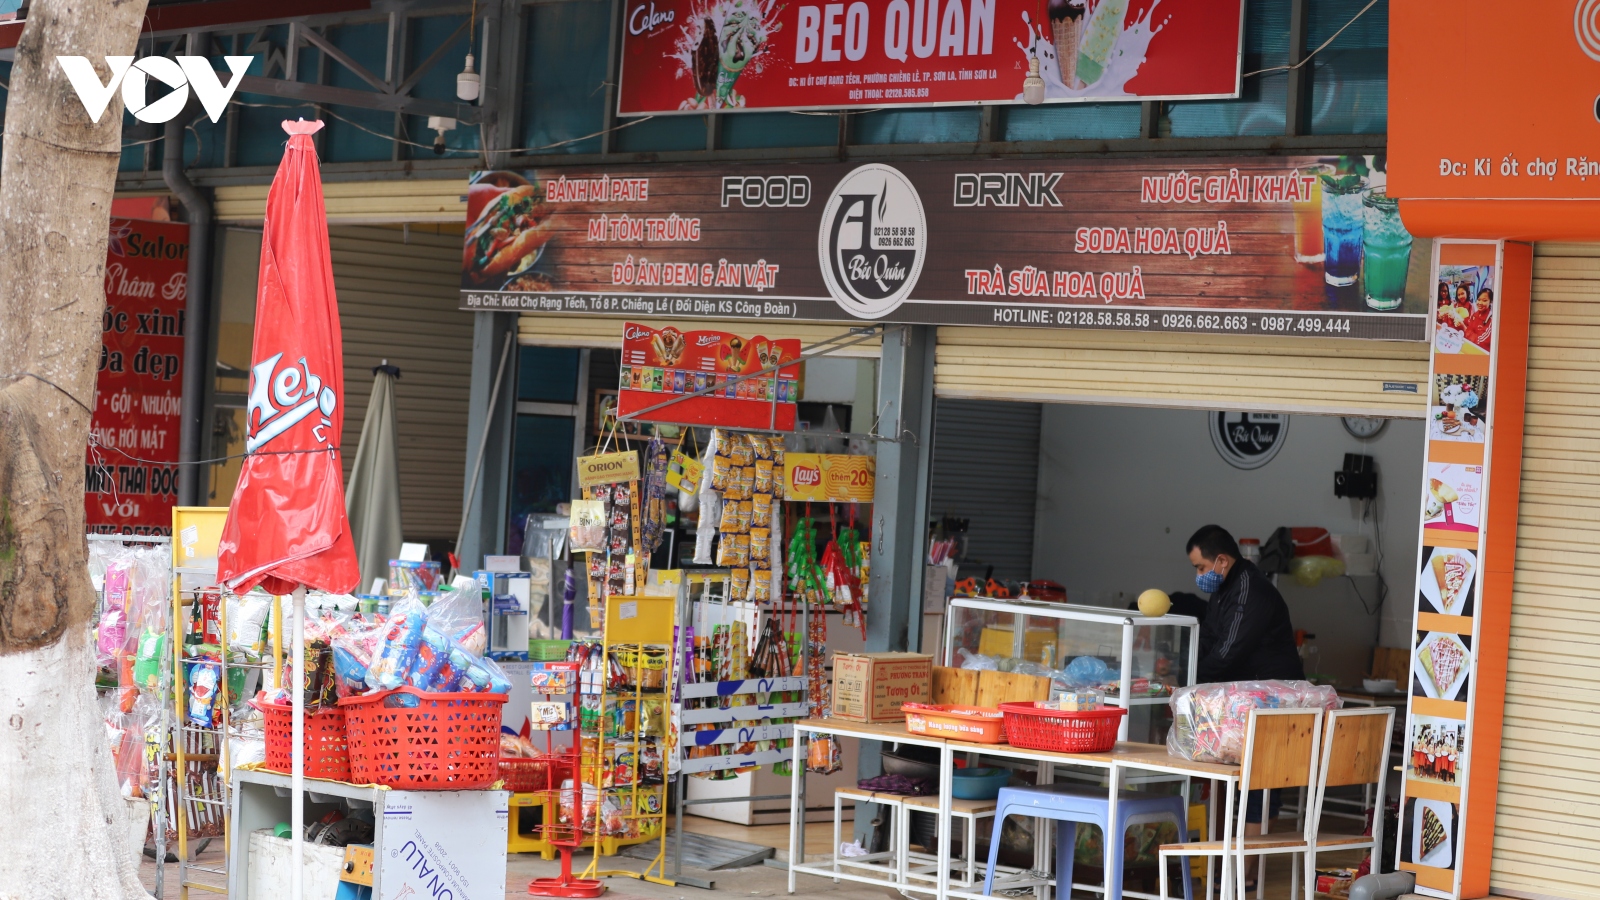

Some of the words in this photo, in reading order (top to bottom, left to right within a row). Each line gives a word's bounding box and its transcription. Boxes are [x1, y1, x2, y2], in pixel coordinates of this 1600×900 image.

[629, 1, 675, 36] Celano
[923, 72, 932, 82] TP.
[989, 69, 997, 79] LA
[1439, 158, 1467, 176] Đc:
[1474, 158, 1491, 176] Ki
[1500, 153, 1518, 176] ốt
[1526, 158, 1558, 182] chợ
[546, 174, 590, 203] BÁNH
[590, 174, 610, 202] MÌ
[611, 178, 649, 201] PATE
[721, 175, 811, 207] FOOD
[953, 172, 1064, 207] DRINK
[1141, 169, 1201, 204] NƯỚC
[1204, 168, 1250, 203] GIẢI
[1252, 168, 1317, 204] KHÁT
[587, 213, 608, 242] MÌ
[610, 216, 644, 242] TÔM
[647, 212, 700, 242] TRỨNG
[874, 227, 890, 236] 02128
[892, 227, 899, 236] 58
[900, 227, 907, 236] 58
[908, 227, 916, 236] 58
[1074, 226, 1132, 255] SODA
[1133, 227, 1181, 255] HOA
[1183, 220, 1232, 260] QUẢ
[878, 238, 892, 246] 0926
[904, 238, 915, 246] 663
[611, 254, 636, 286] ĐỒ
[637, 258, 660, 286] ĂN
[663, 263, 699, 286] ĐEM
[700, 263, 714, 286] &
[716, 258, 742, 288] ĂN
[744, 259, 779, 292] VẶT
[848, 254, 872, 280] Béo
[874, 254, 906, 292] Quán
[965, 263, 1007, 296] TRÀ
[1008, 264, 1050, 297] SỮA
[1052, 271, 1098, 298] HOA
[1099, 265, 1146, 304] QUẢ
[467, 294, 481, 308] Địa
[482, 294, 500, 307] Chỉ:
[502, 296, 519, 308] Kiot
[520, 296, 538, 310] Chợ
[540, 296, 562, 311] Rạng
[564, 296, 588, 311] Tếch,
[590, 295, 602, 310] Tổ
[603, 298, 610, 310] 8
[611, 298, 619, 310] P.
[676, 298, 692, 312] Đối
[694, 300, 716, 314] Diện
[718, 300, 732, 313] KS
[735, 301, 761, 316] Công
[764, 302, 790, 315] Đoàn
[626, 327, 650, 340] Celano
[994, 308, 1053, 324] HOTLINE:
[1057, 311, 1150, 327] 02128.58.58.58
[1162, 314, 1248, 330] 0926.662.663
[1260, 317, 1350, 332] 0987.499.444
[697, 334, 720, 345] Merino
[133, 346, 178, 380] đẹp
[111, 387, 131, 420] GỘI
[140, 424, 166, 456] MẶT
[588, 461, 623, 473] ORION
[102, 498, 140, 518] VỚI
[414, 828, 428, 850] PANEL
[434, 841, 448, 858] 2008
[427, 848, 454, 882] COMPOSITE
